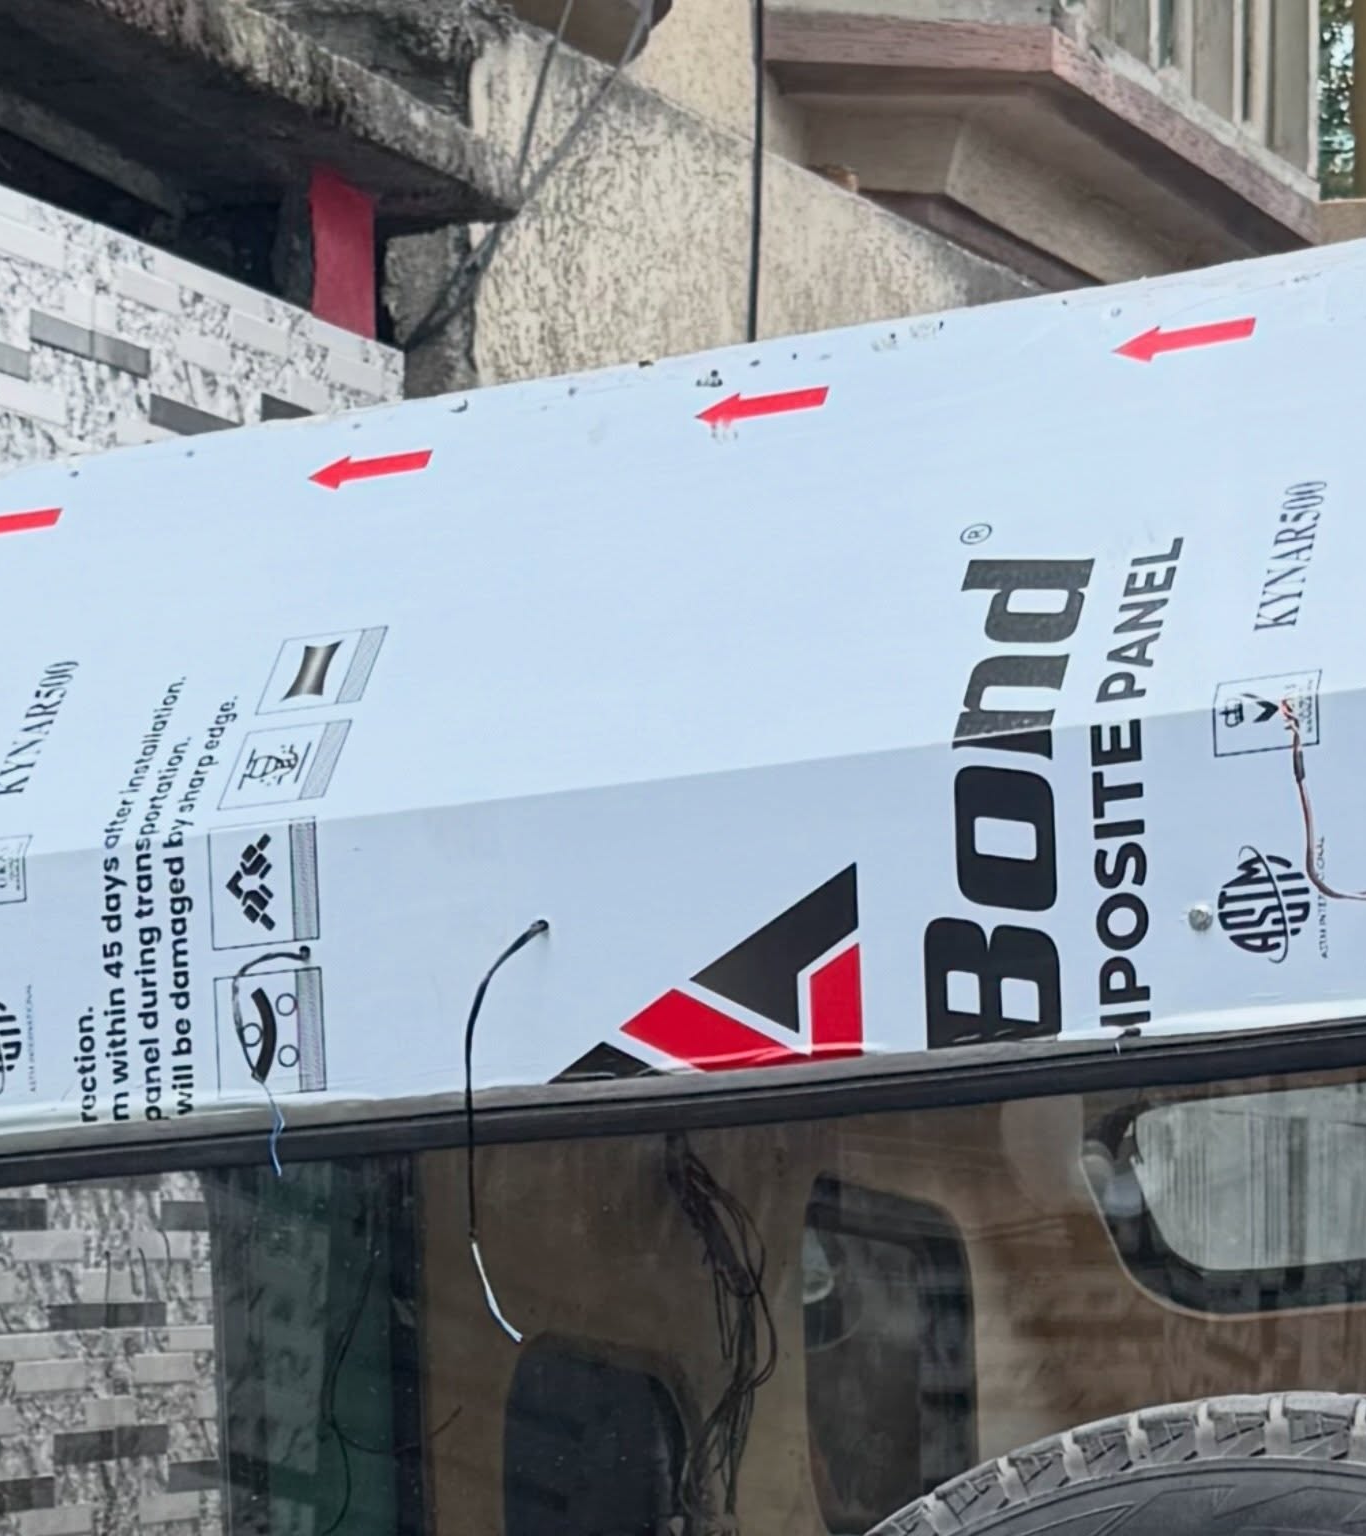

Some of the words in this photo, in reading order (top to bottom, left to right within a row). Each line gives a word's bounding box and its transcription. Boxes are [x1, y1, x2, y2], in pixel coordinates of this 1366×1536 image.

[1254, 480, 1327, 632] KYNAR500
[1095, 536, 1185, 703] PANEL
[129, 675, 187, 795] installation.
[203, 694, 240, 750] edge.
[103, 799, 136, 849] after
[132, 735, 192, 918] transportation.
[162, 816, 194, 848] by
[178, 755, 218, 813] sharp
[924, 558, 1095, 1049] Bond
[101, 857, 128, 933] days
[163, 856, 193, 1010] damaged
[1218, 855, 1295, 953] ASTM
[102, 942, 125, 979] 45
[134, 926, 164, 1031] during
[75, 1006, 95, 1122] rection.
[104, 988, 130, 1085] within
[137, 1038, 169, 1121] panel
[169, 1018, 193, 1056] be
[171, 1063, 195, 1115] will
